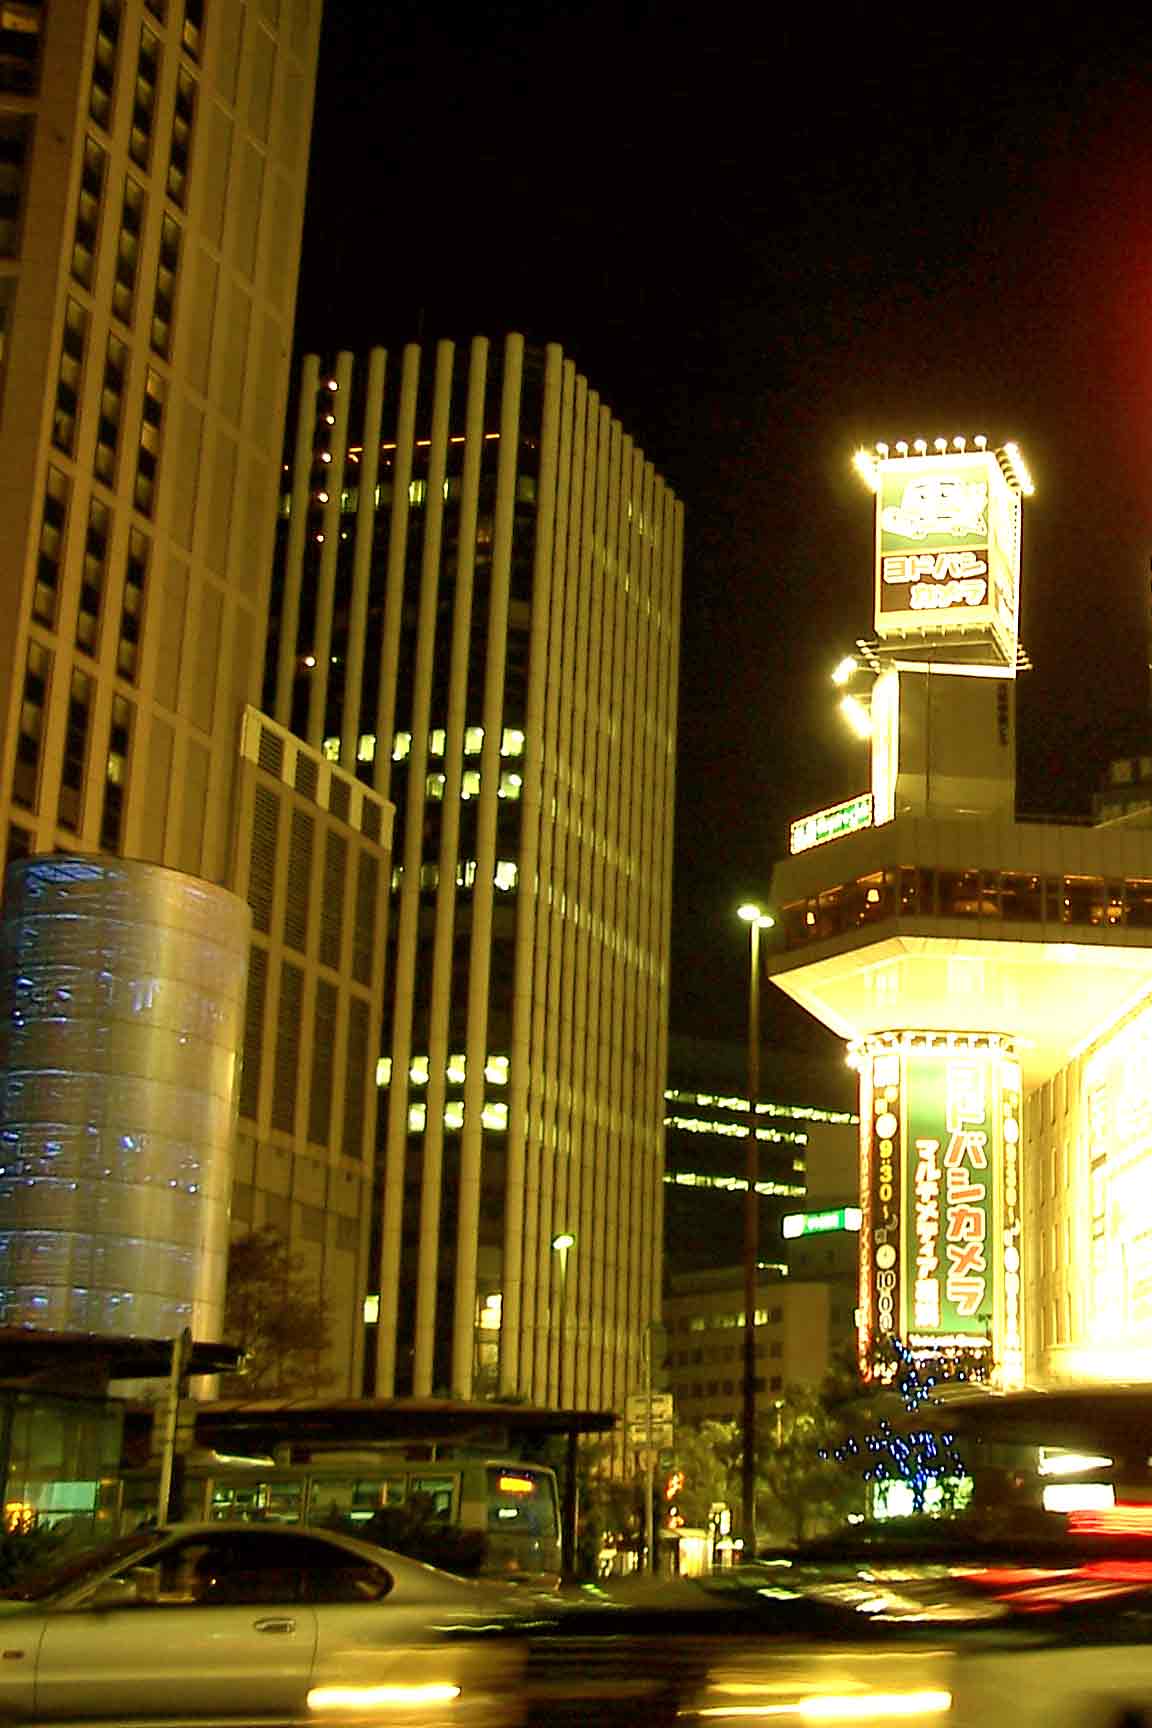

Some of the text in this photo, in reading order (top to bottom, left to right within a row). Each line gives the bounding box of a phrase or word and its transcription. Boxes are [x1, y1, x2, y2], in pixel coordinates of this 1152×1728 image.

[944, 1061, 987, 1316] ヨドバシカメラ
